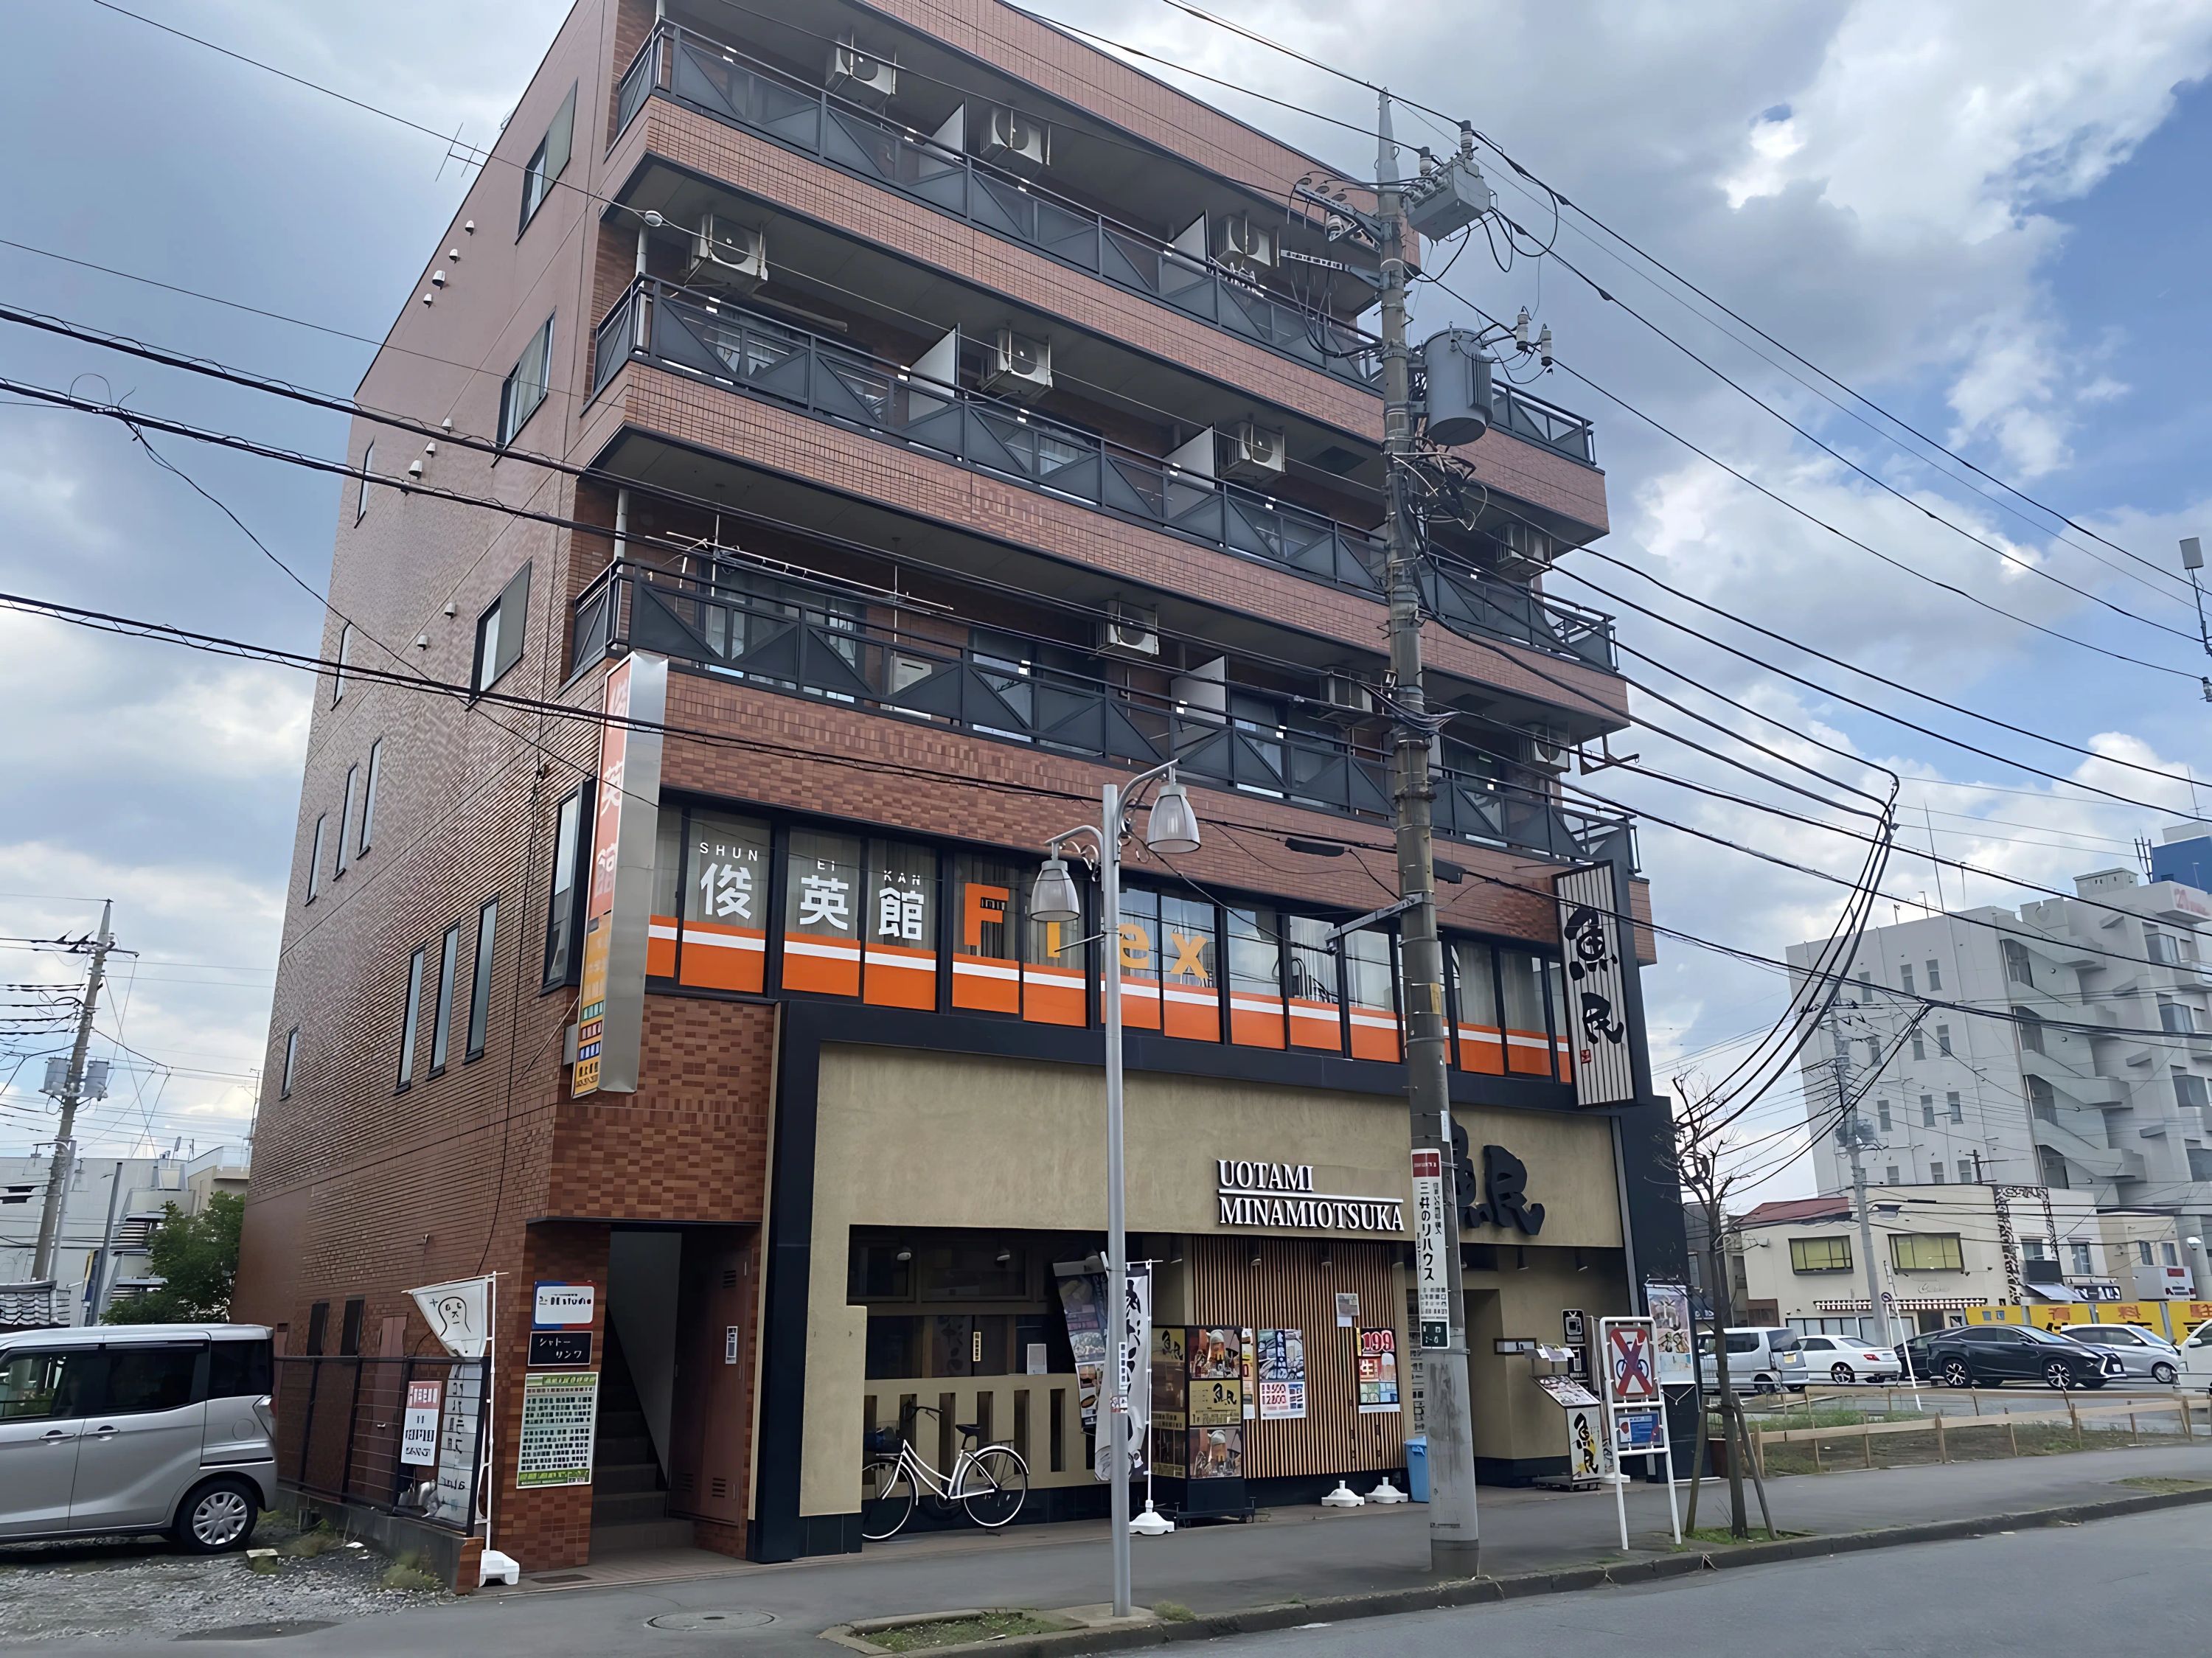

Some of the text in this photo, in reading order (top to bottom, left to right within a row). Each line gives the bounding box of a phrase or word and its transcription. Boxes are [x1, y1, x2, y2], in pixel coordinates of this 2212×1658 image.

[700, 842, 758, 861] SHUN
[700, 863, 925, 941] 俊英館
[1217, 1159, 1314, 1191] UOTAMI
[1218, 1196, 1405, 1231] MINAMIOTSUKA
[1419, 1181, 1435, 1281] 三井のリハウス
[1362, 1330, 1394, 1352] 199
